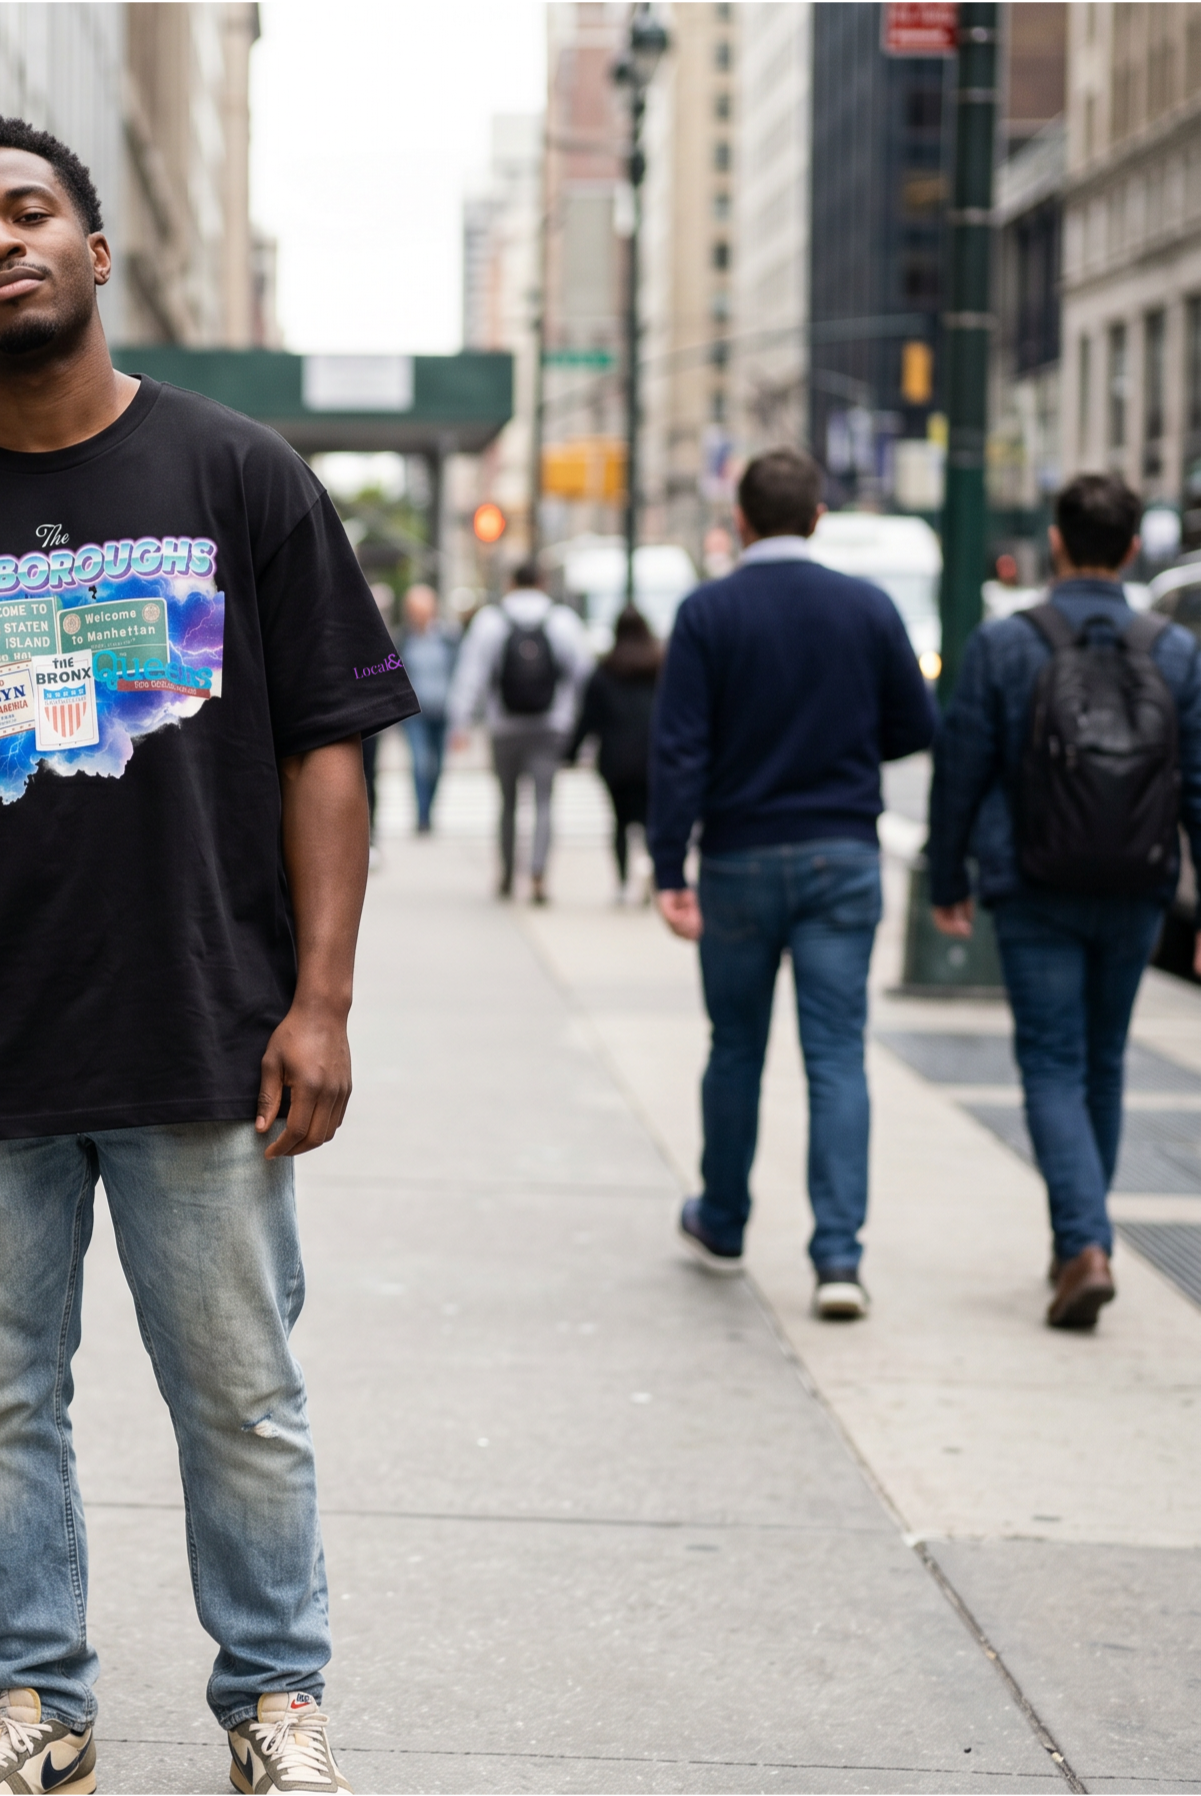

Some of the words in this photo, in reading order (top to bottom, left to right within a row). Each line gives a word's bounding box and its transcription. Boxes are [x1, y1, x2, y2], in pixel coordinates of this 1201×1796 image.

[35, 523, 70, 548] The
[30, 603, 48, 615] TO
[84, 609, 137, 625] Welcome
[3, 620, 49, 634] STATEN
[5, 636, 50, 650] ISLAND
[35, 666, 92, 685] BRONX
[92, 649, 214, 691] Queens
